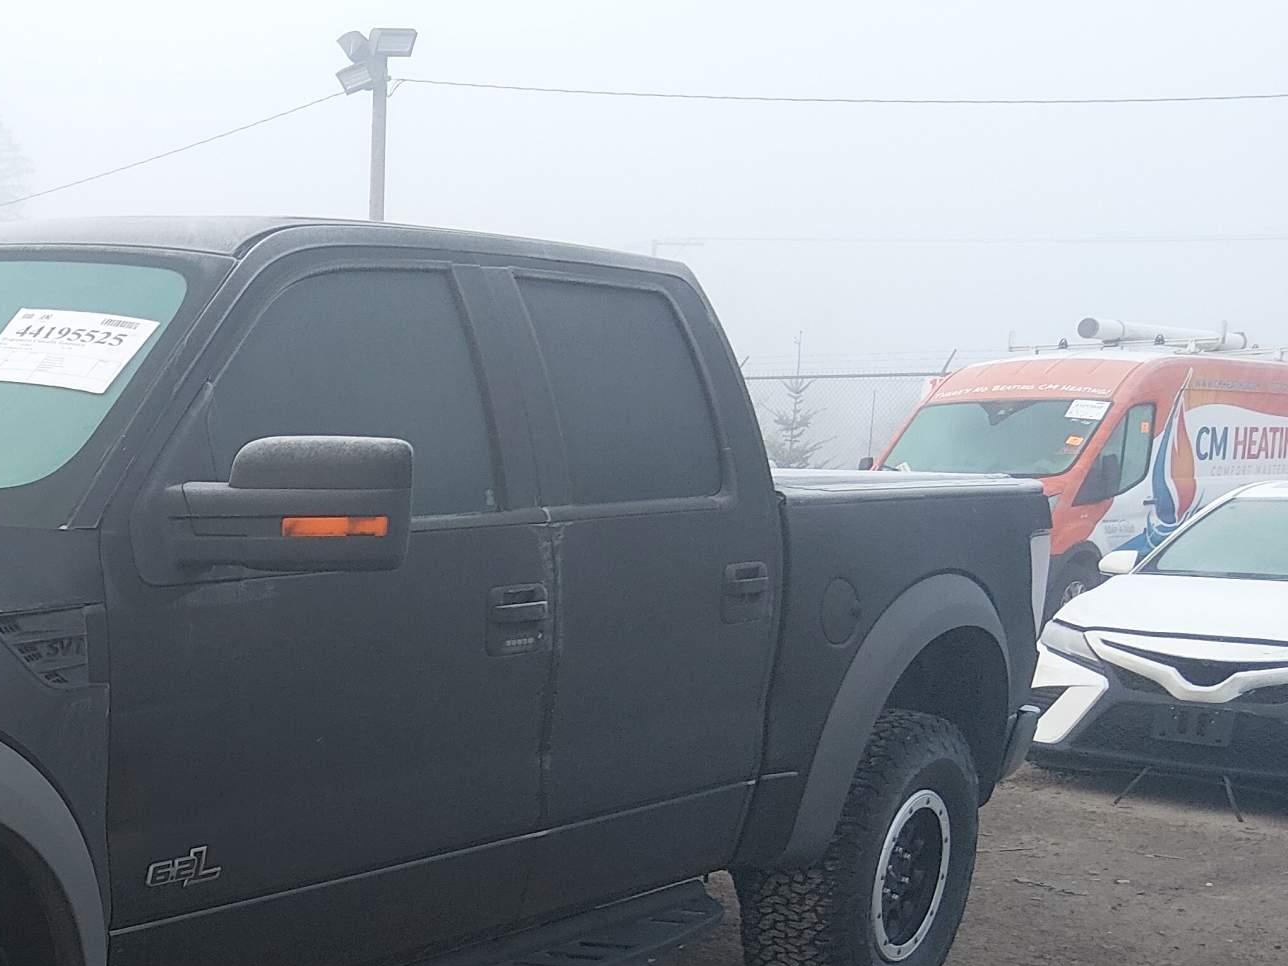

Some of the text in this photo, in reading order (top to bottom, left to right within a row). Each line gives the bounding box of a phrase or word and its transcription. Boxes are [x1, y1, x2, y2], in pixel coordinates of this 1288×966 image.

[16, 324, 128, 347] 44195525
[1038, 383, 1060, 391] CM
[1195, 426, 1228, 461] CM
[145, 845, 222, 888] 6.2L
